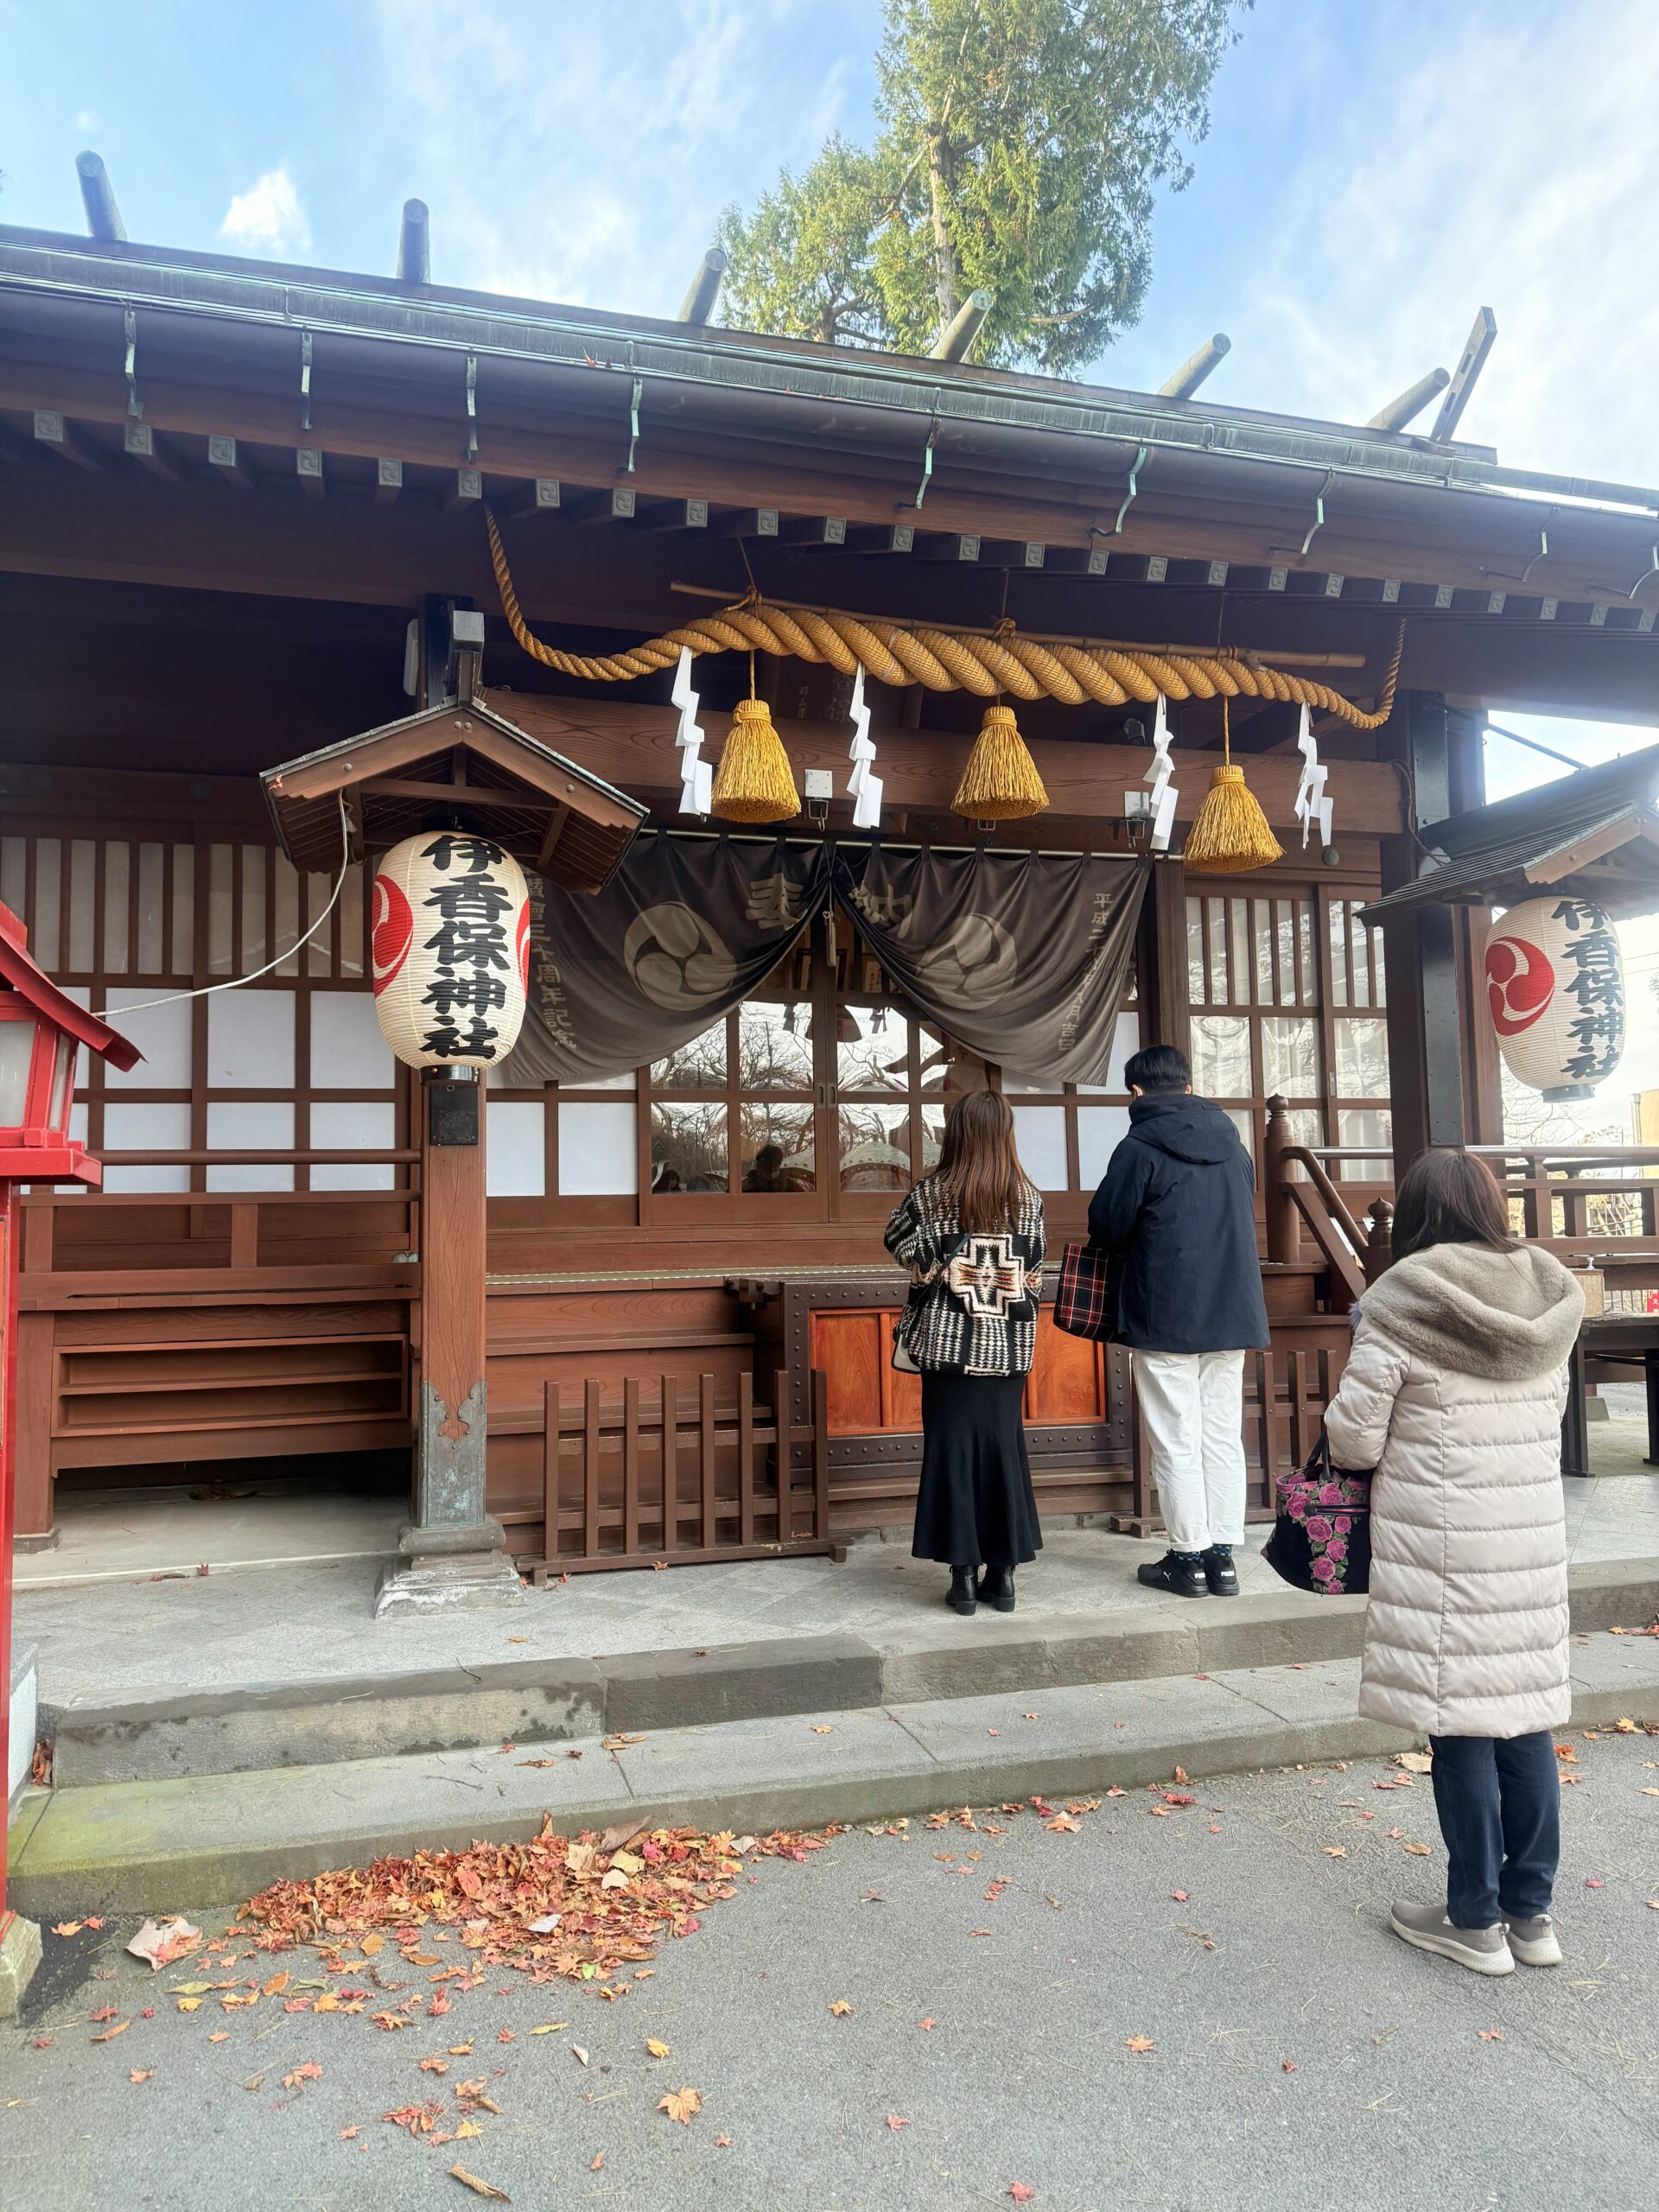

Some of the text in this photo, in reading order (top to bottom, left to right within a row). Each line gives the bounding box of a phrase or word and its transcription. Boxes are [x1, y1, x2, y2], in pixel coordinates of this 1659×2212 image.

[419, 835, 513, 1058] 伊香保神社
[1552, 900, 1624, 1079] 伊香保神社
